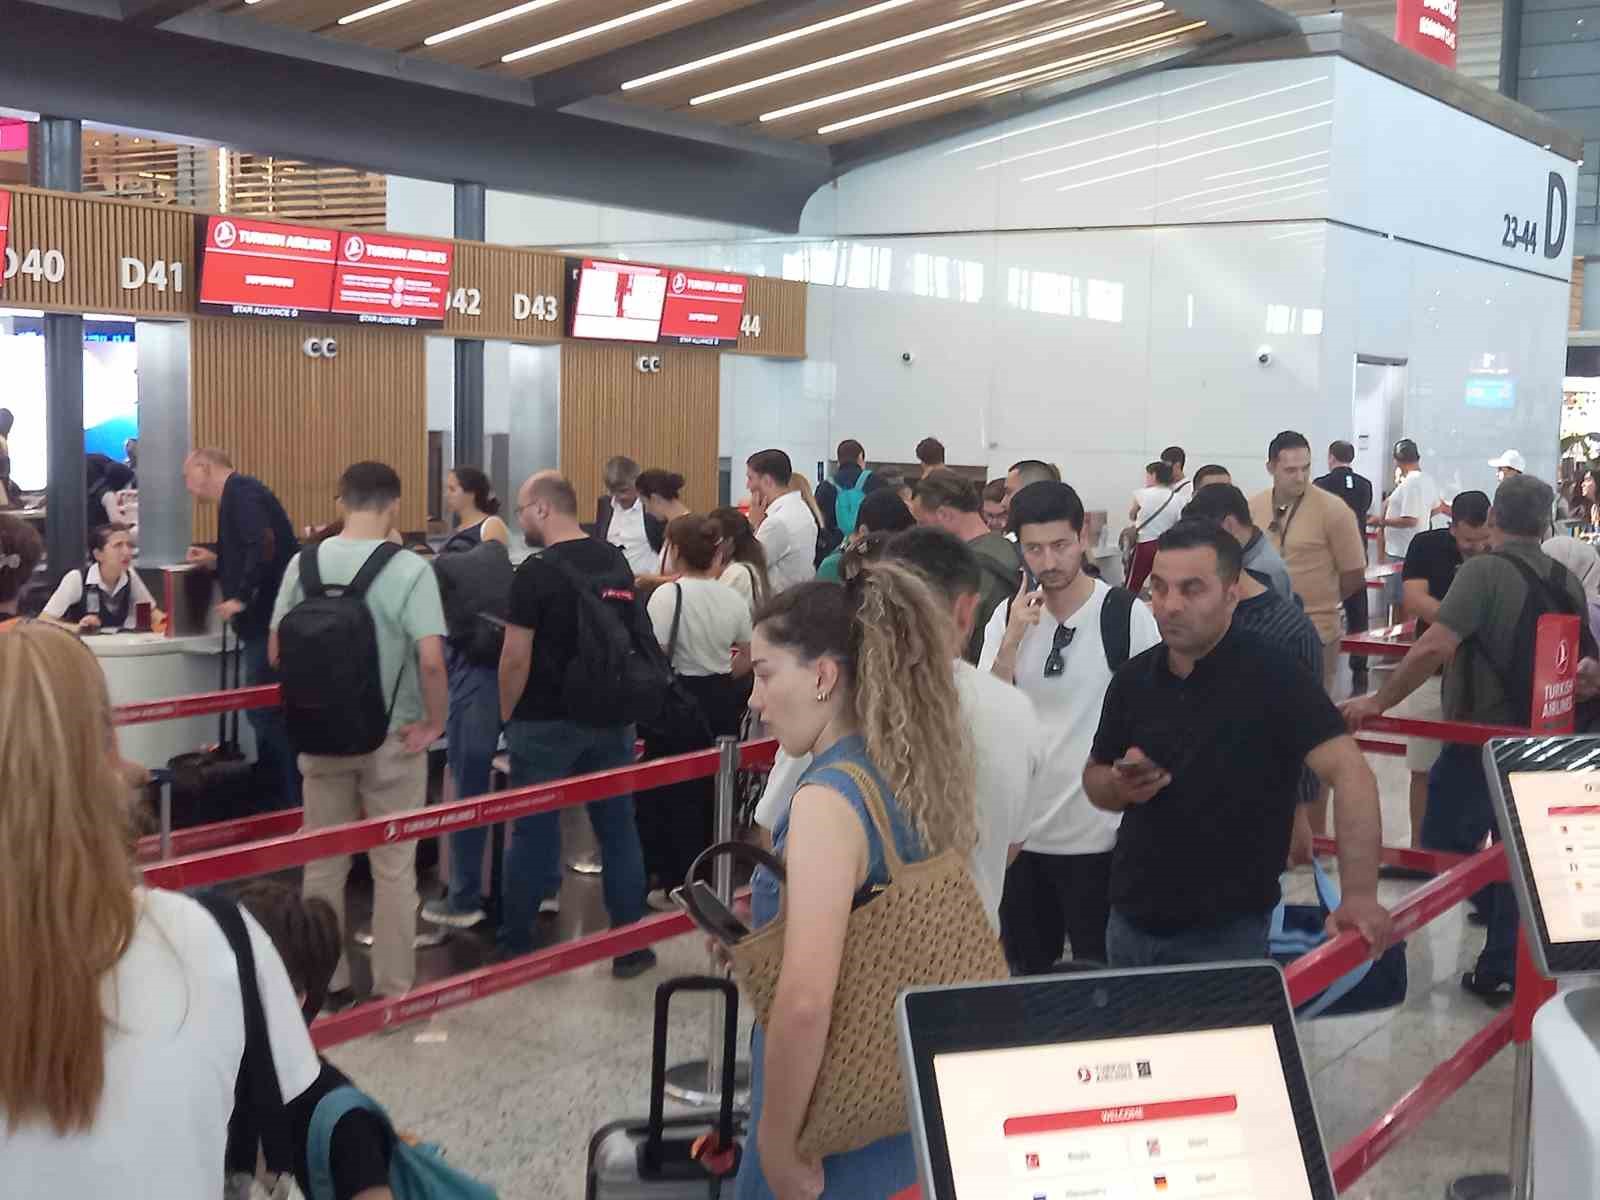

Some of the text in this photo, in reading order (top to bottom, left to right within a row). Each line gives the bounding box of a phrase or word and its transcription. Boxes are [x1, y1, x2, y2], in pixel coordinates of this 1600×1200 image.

[1502, 171, 1568, 259] 23-44 D
[120, 256, 183, 293] D41
[445, 287, 481, 316] 42
[514, 292, 558, 321] D43
[1101, 1106, 1145, 1124] WELCOME
